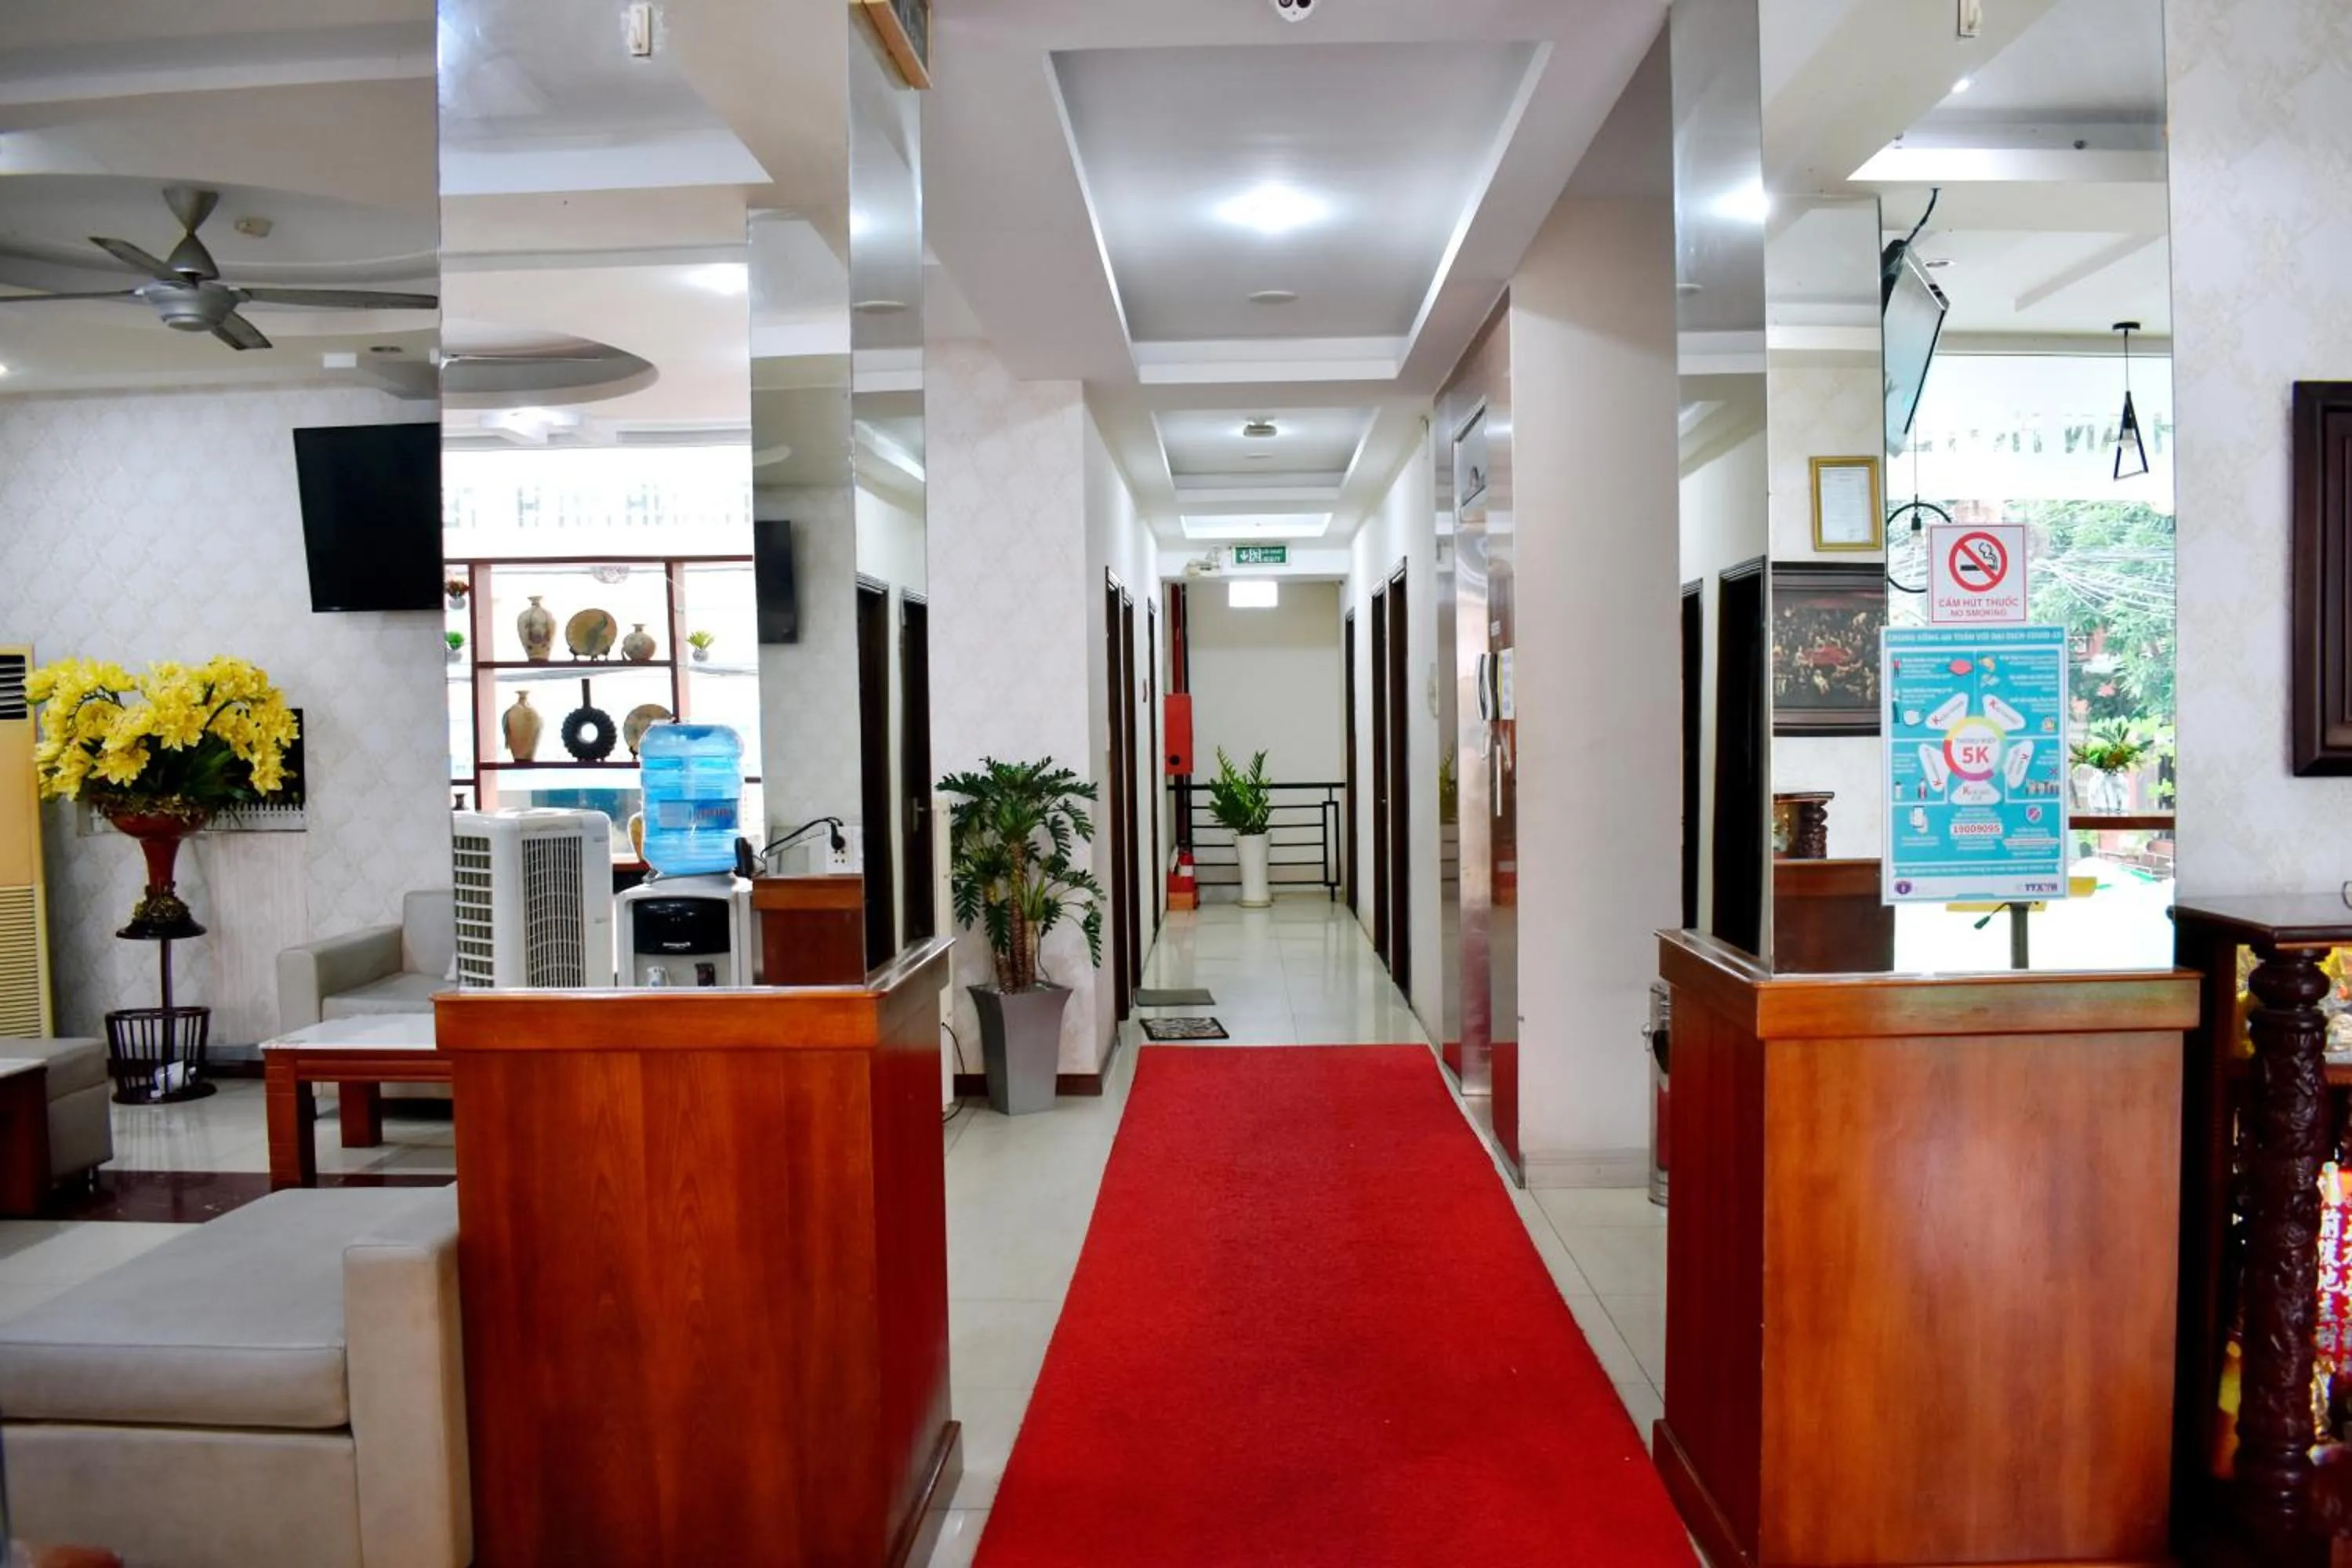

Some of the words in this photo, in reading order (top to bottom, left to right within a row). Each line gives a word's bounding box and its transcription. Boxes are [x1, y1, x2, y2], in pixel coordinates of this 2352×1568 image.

[1965, 608, 2007, 616] SMOKING
[1962, 746, 1989, 763] 5K
[1953, 824, 2000, 833] 19009095
